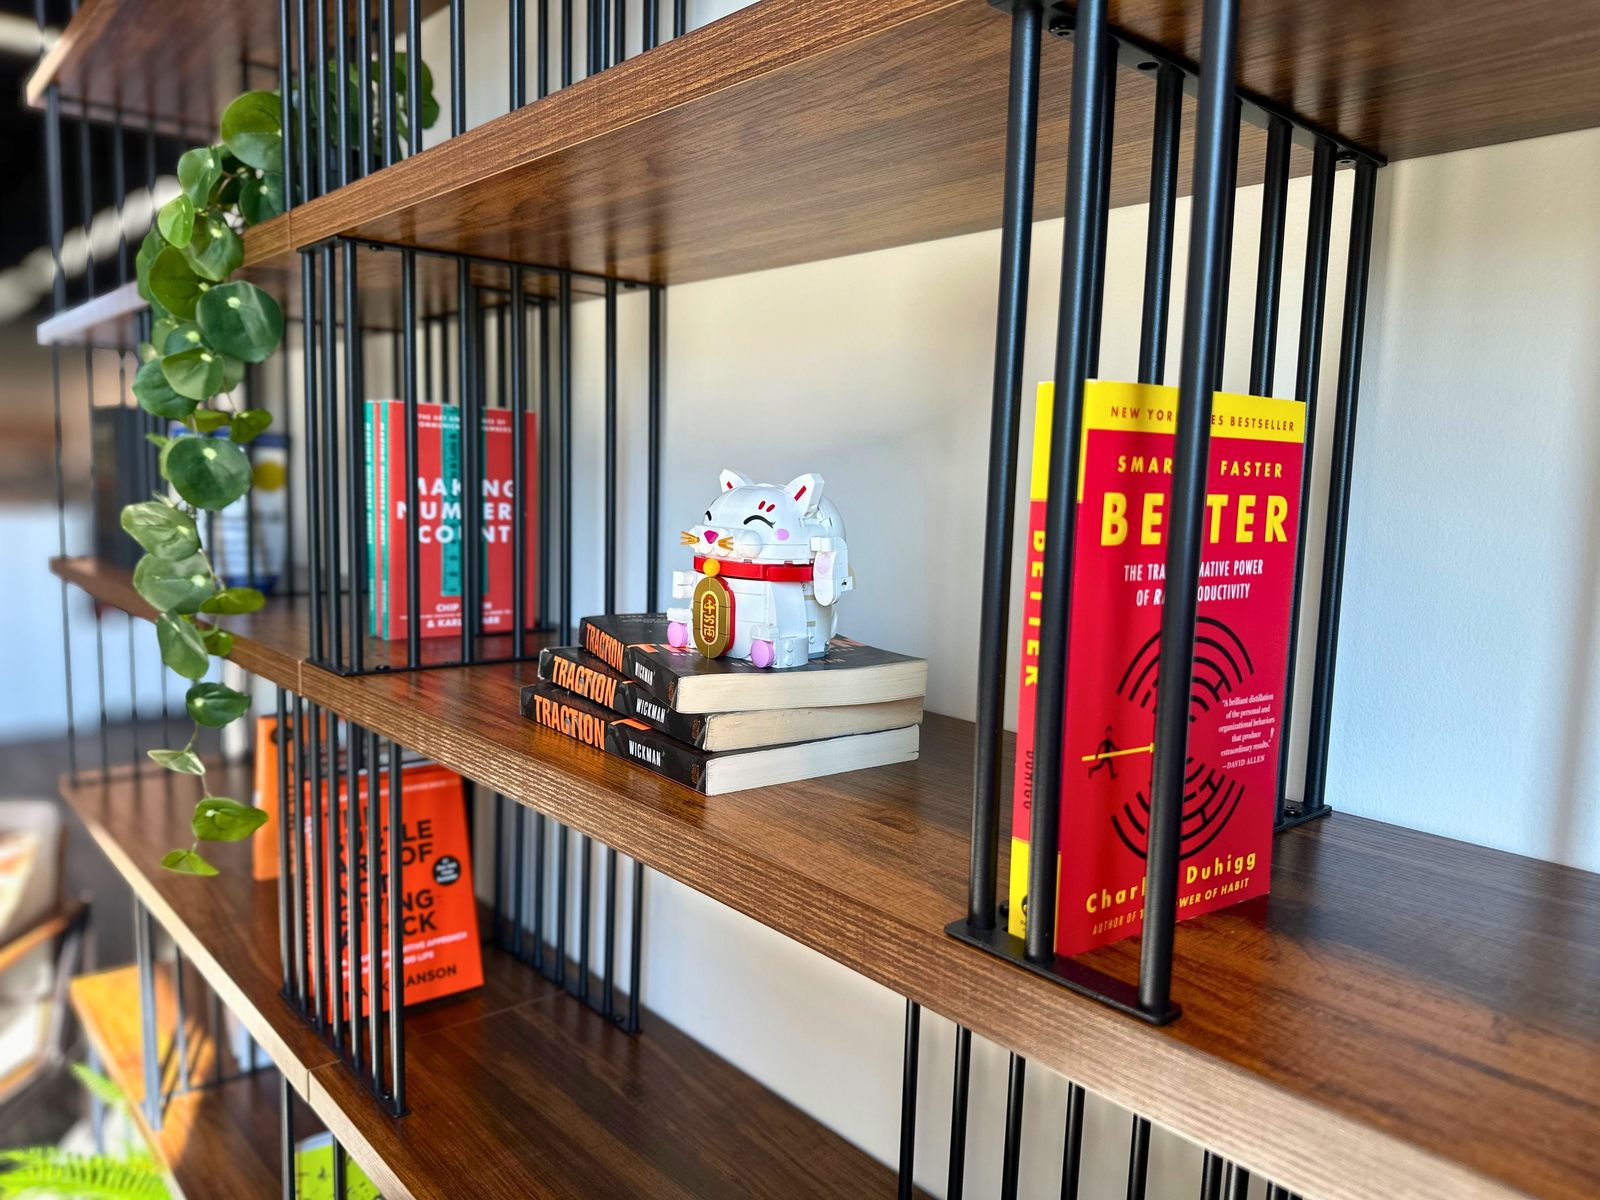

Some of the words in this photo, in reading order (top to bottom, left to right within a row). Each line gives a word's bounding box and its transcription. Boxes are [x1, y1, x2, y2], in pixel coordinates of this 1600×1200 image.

[1111, 406, 1139, 418] NEW
[1147, 408, 1173, 421] YOR
[1230, 416, 1294, 431] BESTSELLER
[1118, 455, 1173, 474] SMAR
[1220, 460, 1283, 478] FASTER
[1100, 492, 1289, 546] BETER
[418, 525, 511, 544] CONT
[1124, 564, 1143, 582] THE
[1233, 559, 1263, 576] POWER
[1136, 589, 1150, 606] OF
[585, 622, 624, 672] TRACTION
[552, 655, 617, 709] TRACTION
[634, 661, 653, 686] WICKMAN
[533, 694, 605, 750] TRACTION
[636, 697, 666, 723] WICKMAN
[628, 740, 661, 767] WICKMAN
[1246, 754, 1265, 766] ALLEN
[1085, 876, 1147, 914] Charl
[1186, 852, 1256, 885] Duhigg
[1092, 915, 1124, 936] AUTHOR
[1126, 911, 1137, 924] OF
[1204, 888, 1218, 900] OF
[1220, 877, 1250, 896] HABIT
[405, 964, 458, 988] ANSON
